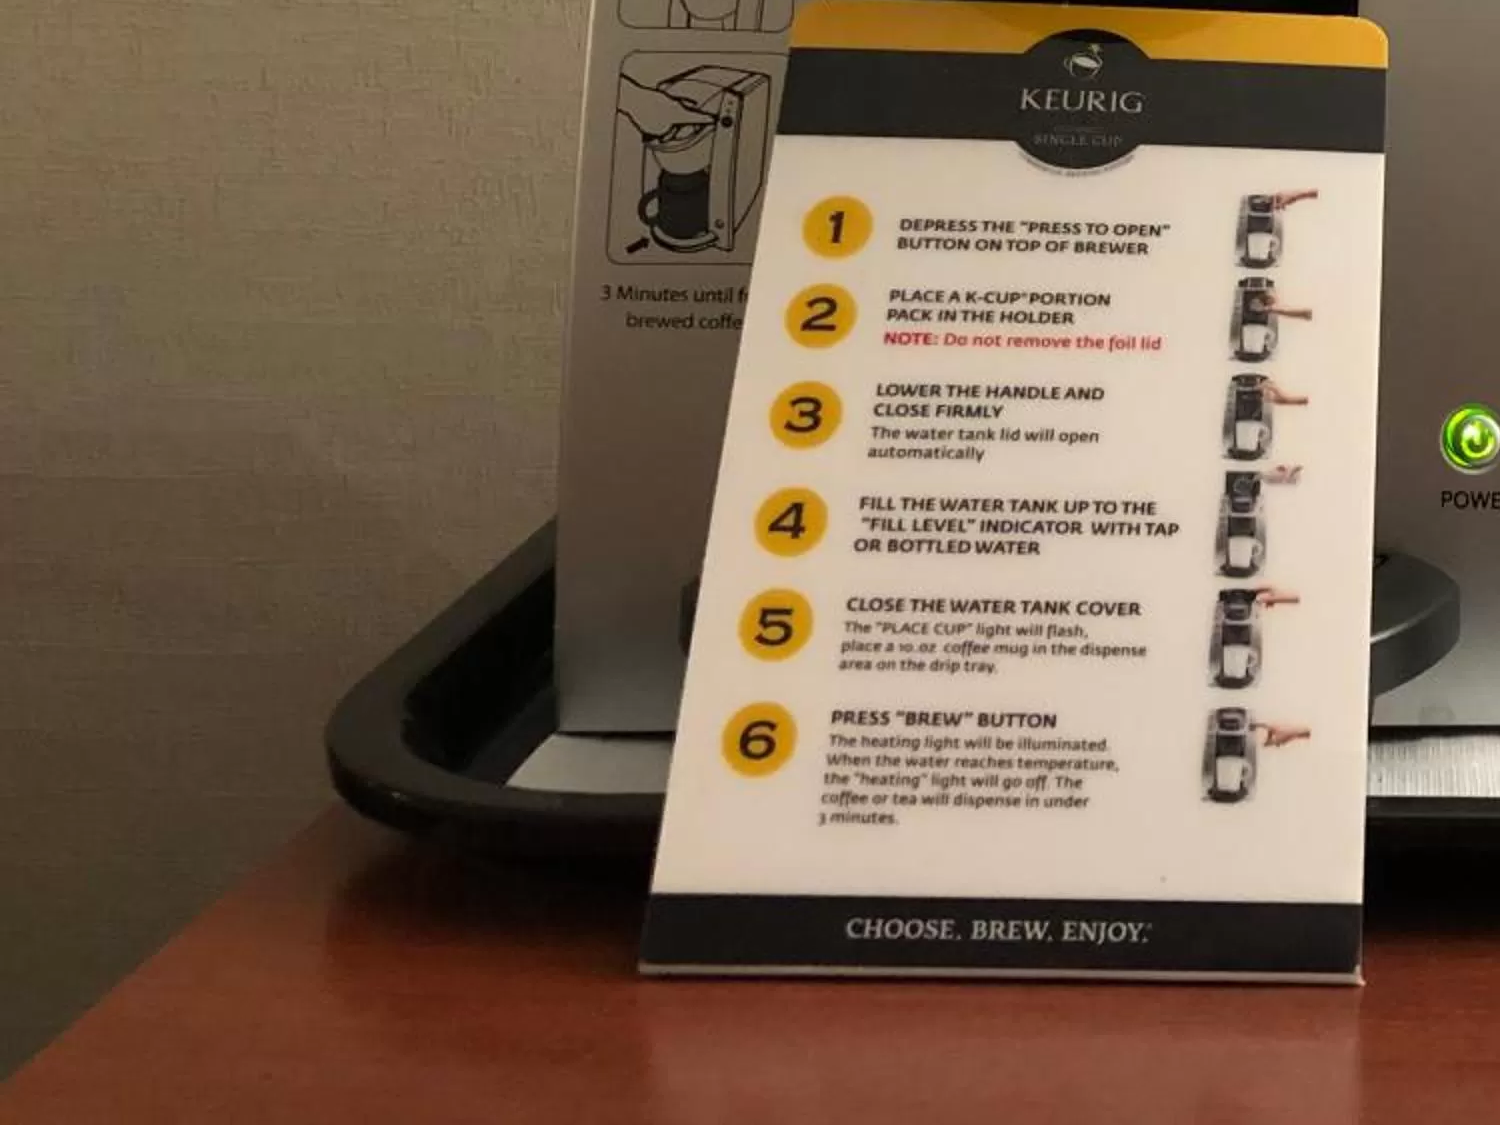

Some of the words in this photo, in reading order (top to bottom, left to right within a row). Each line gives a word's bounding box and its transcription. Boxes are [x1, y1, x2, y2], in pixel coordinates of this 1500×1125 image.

[1020, 87, 1144, 114] KEURIG
[828, 211, 846, 244] 1
[900, 218, 977, 232] DEPRESS
[982, 220, 1016, 234] THE
[1086, 223, 1110, 235] TO
[897, 237, 970, 252] BUTTON
[975, 239, 1002, 252] ON
[1005, 239, 1041, 253] TOP
[1045, 241, 1069, 253] OF
[1073, 241, 1148, 255] BREWER
[601, 284, 610, 300] 3
[617, 285, 688, 302] Minutes
[693, 287, 733, 304] until
[889, 290, 944, 304] PLACE
[948, 291, 961, 304] A
[1029, 292, 1111, 307] PORTION
[625, 311, 694, 329] brewed
[700, 314, 744, 331] coffe
[800, 297, 838, 332] 2
[886, 309, 932, 323] PACK
[938, 310, 957, 323] IN
[961, 310, 995, 323] THE
[1000, 310, 1074, 325] HOLDER
[883, 332, 939, 346] NOTE:
[943, 334, 967, 346] Do
[972, 334, 1002, 347] not
[1006, 336, 1072, 348] remove
[1075, 335, 1105, 348] the
[1108, 336, 1136, 353] foil
[1140, 336, 1161, 351] lid
[876, 383, 942, 398] LOWER
[946, 384, 981, 399] THE
[985, 386, 1061, 400] HANDLE
[1064, 386, 1105, 401] AND
[784, 397, 823, 434] 3
[873, 403, 931, 418] CLOSE
[935, 404, 1003, 419] FIRMLY
[871, 426, 901, 440] The
[904, 429, 954, 441] water
[958, 428, 996, 442] tank
[1000, 427, 1021, 442] lid
[1025, 428, 1055, 442] will
[1058, 431, 1100, 446] open
[867, 446, 985, 463] automatically
[859, 496, 896, 511] FILL
[900, 497, 936, 511] THE
[939, 498, 1004, 513] WATER
[1009, 499, 1058, 513] TANK
[1064, 499, 1090, 514] UP
[1092, 500, 1117, 515] TO
[1121, 501, 1157, 515] THE
[767, 502, 806, 539] 4
[980, 519, 1083, 535] INDICATOR
[1091, 521, 1142, 536] WITH
[1144, 522, 1180, 537] TAP
[853, 538, 882, 552] OR
[887, 538, 972, 554] BOTTLED
[975, 540, 1041, 555] WATER
[846, 597, 905, 612] CLOSE
[910, 598, 947, 614] THE
[949, 599, 1016, 614] WATER
[1020, 600, 1070, 615] TANK
[1076, 601, 1142, 616] COVER
[754, 607, 795, 646] 5
[844, 621, 872, 634] The
[975, 622, 1011, 638] light
[1015, 625, 1044, 637] will
[1046, 625, 1089, 640] flash,
[841, 640, 881, 655] place
[885, 644, 895, 653] a
[943, 642, 991, 658] coffee
[994, 645, 1028, 658] mug
[1033, 643, 1048, 655] in
[1050, 644, 1077, 656] the
[1080, 644, 1147, 660] dispense
[839, 660, 872, 671] area
[876, 660, 896, 671] on
[900, 659, 926, 672] the
[929, 660, 960, 675] drip
[831, 711, 891, 726] PRESS
[977, 713, 1057, 728] BUTTON
[739, 721, 778, 759] 6
[829, 734, 857, 748] The
[860, 735, 920, 752] heating
[924, 736, 961, 752] light
[964, 736, 992, 750] will
[996, 736, 1014, 750] be
[827, 753, 871, 768] When
[875, 754, 901, 768] the
[905, 755, 950, 768] water
[954, 755, 1013, 770] reaches
[1017, 757, 1120, 774] temperature,
[824, 773, 852, 786] the
[931, 774, 967, 791] light
[971, 774, 999, 788] will
[1002, 777, 1022, 792] go
[1055, 776, 1082, 789] The
[821, 792, 869, 808] coffee
[872, 794, 889, 806] or
[893, 793, 918, 806] tea
[921, 793, 950, 807] will
[953, 793, 1021, 810] dispense
[1025, 793, 1040, 808] in
[1043, 794, 1090, 809] under
[818, 813, 826, 827] 3
[846, 917, 962, 940] CHOOSE.
[970, 919, 1052, 941] BREW.
